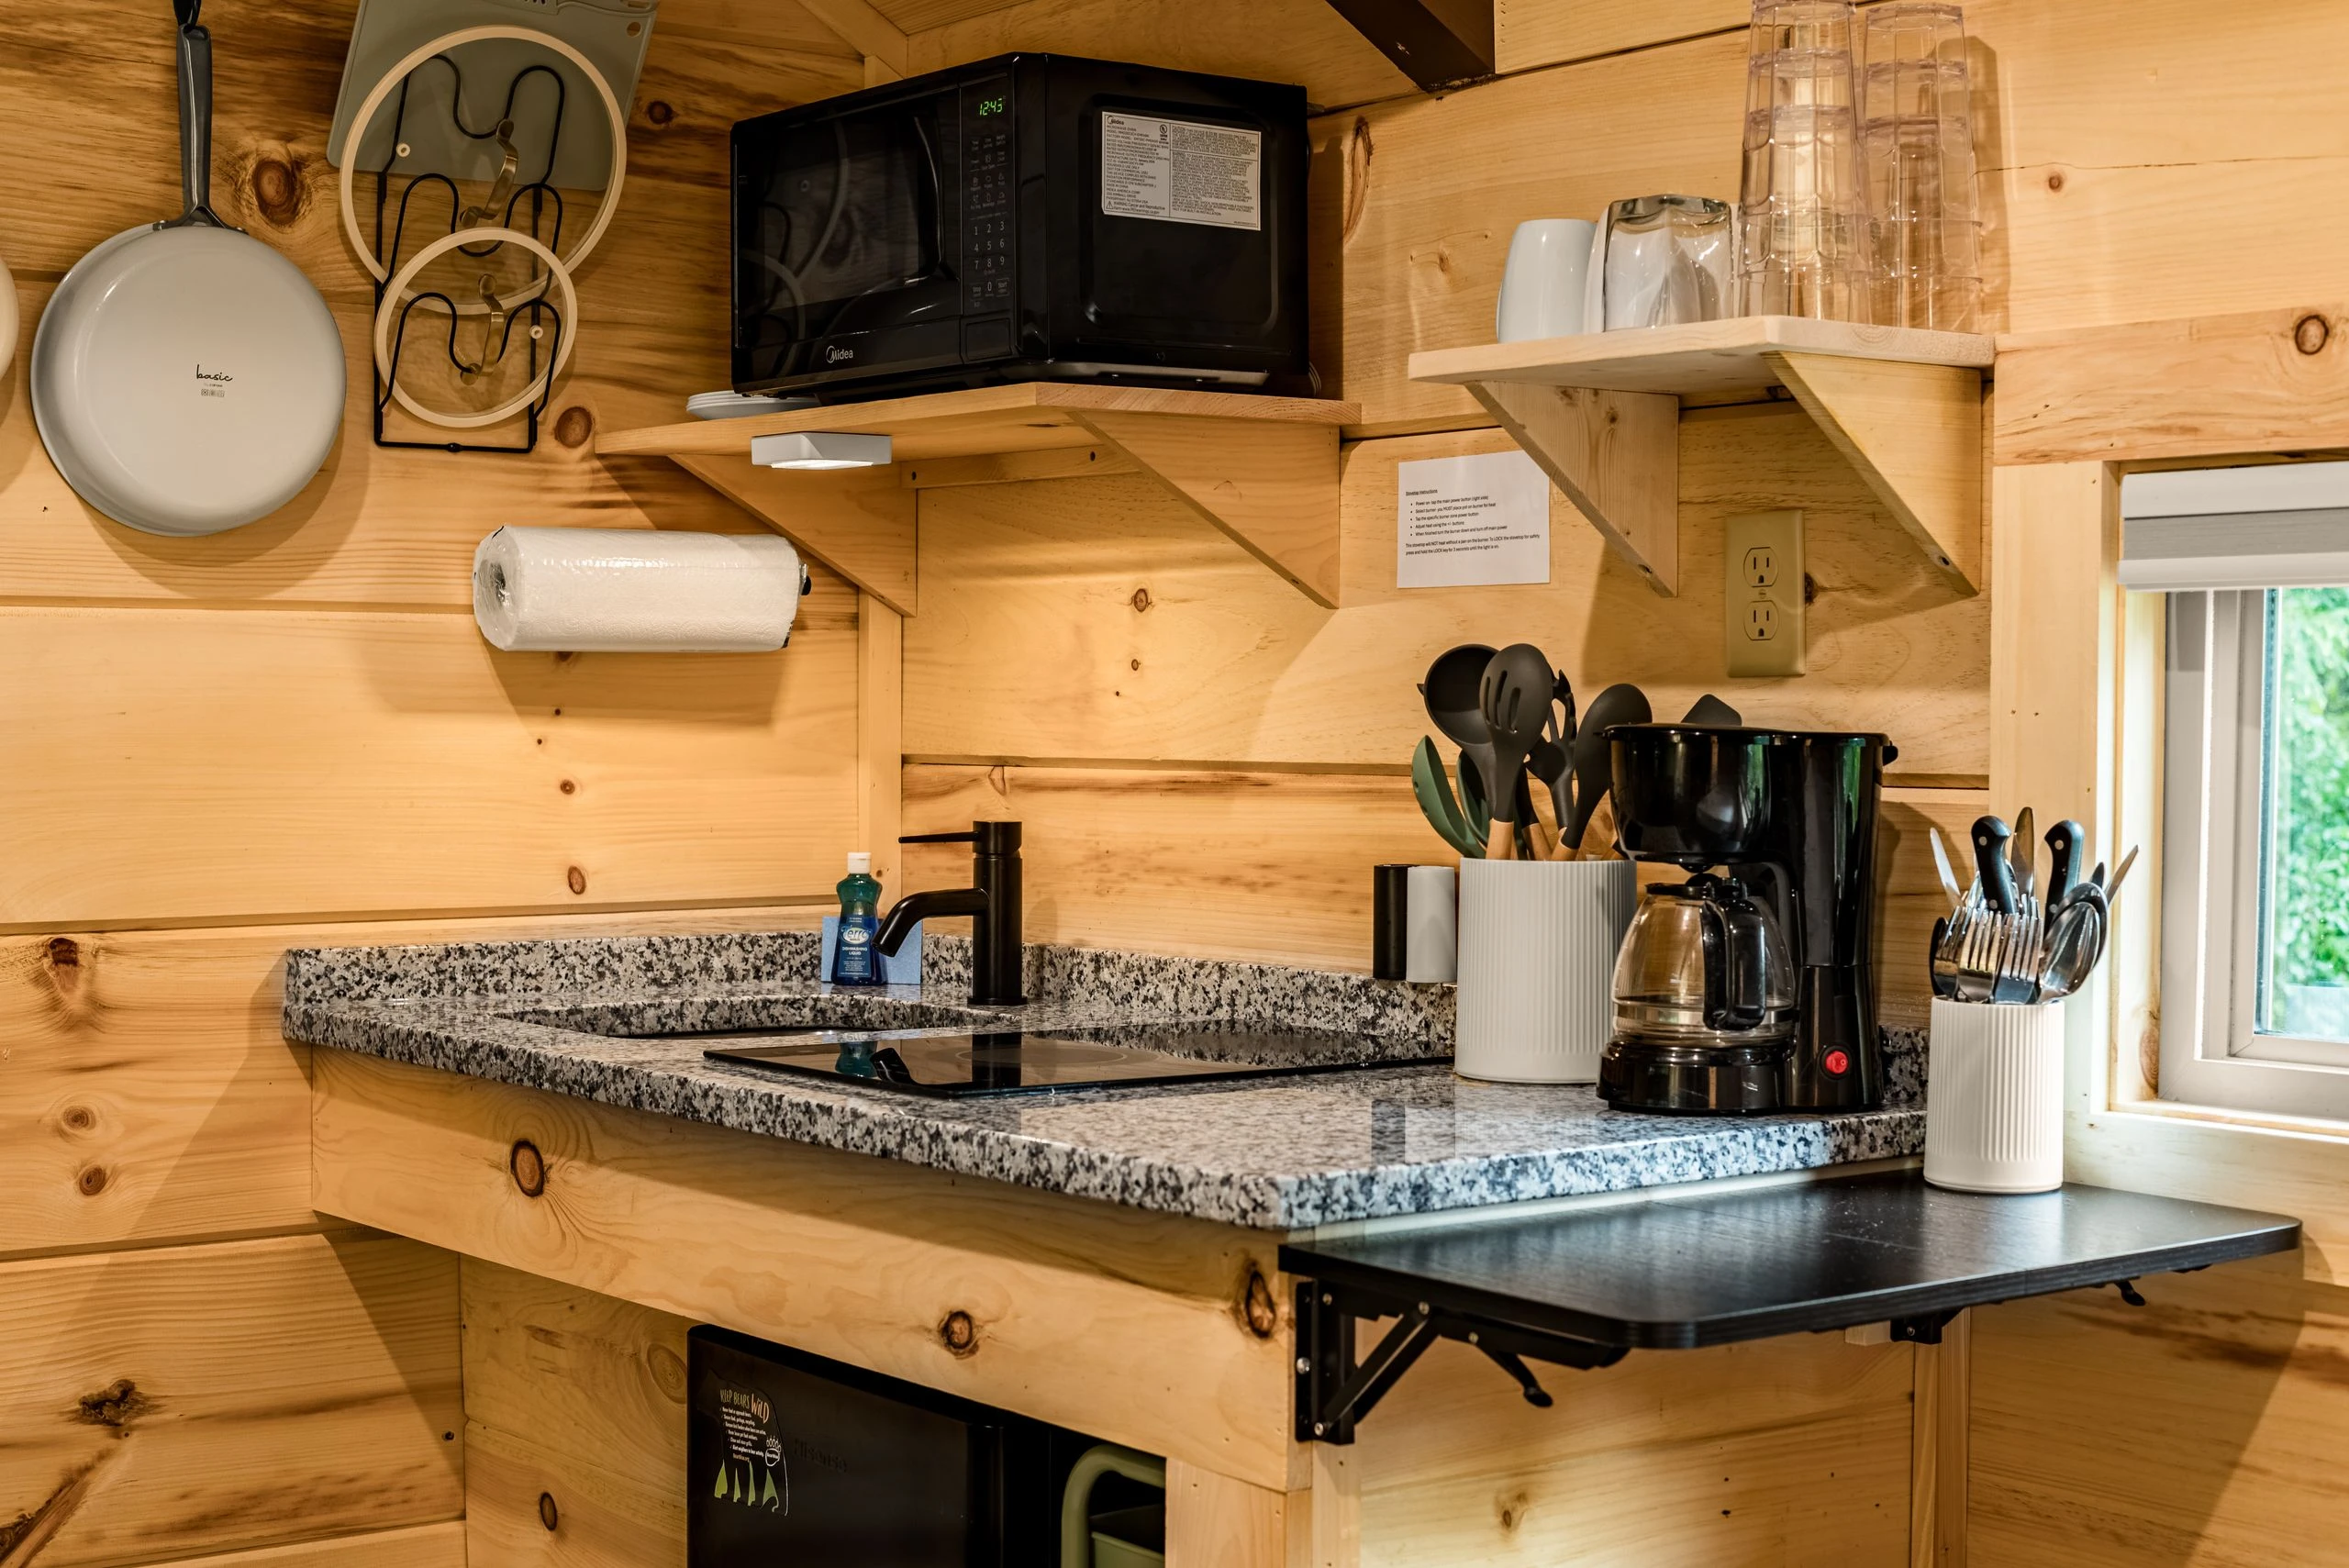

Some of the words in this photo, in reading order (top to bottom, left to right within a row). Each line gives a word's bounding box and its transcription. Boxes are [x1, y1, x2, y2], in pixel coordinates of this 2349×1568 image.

[979, 98, 1003, 116] 12:43
[974, 226, 978, 236] 1
[987, 224, 991, 233] 2
[1000, 221, 1004, 231] 3
[974, 242, 979, 252] 4
[987, 240, 992, 250] 5
[1000, 239, 1005, 248] 6
[974, 260, 978, 270] 7
[987, 258, 992, 267] 8
[1000, 256, 1005, 265] 9
[987, 282, 992, 291] 0
[826, 345, 853, 363] Midea
[196, 363, 233, 382] basic
[720, 1389, 732, 1403] KEEP
[734, 1392, 750, 1409] BEARS
